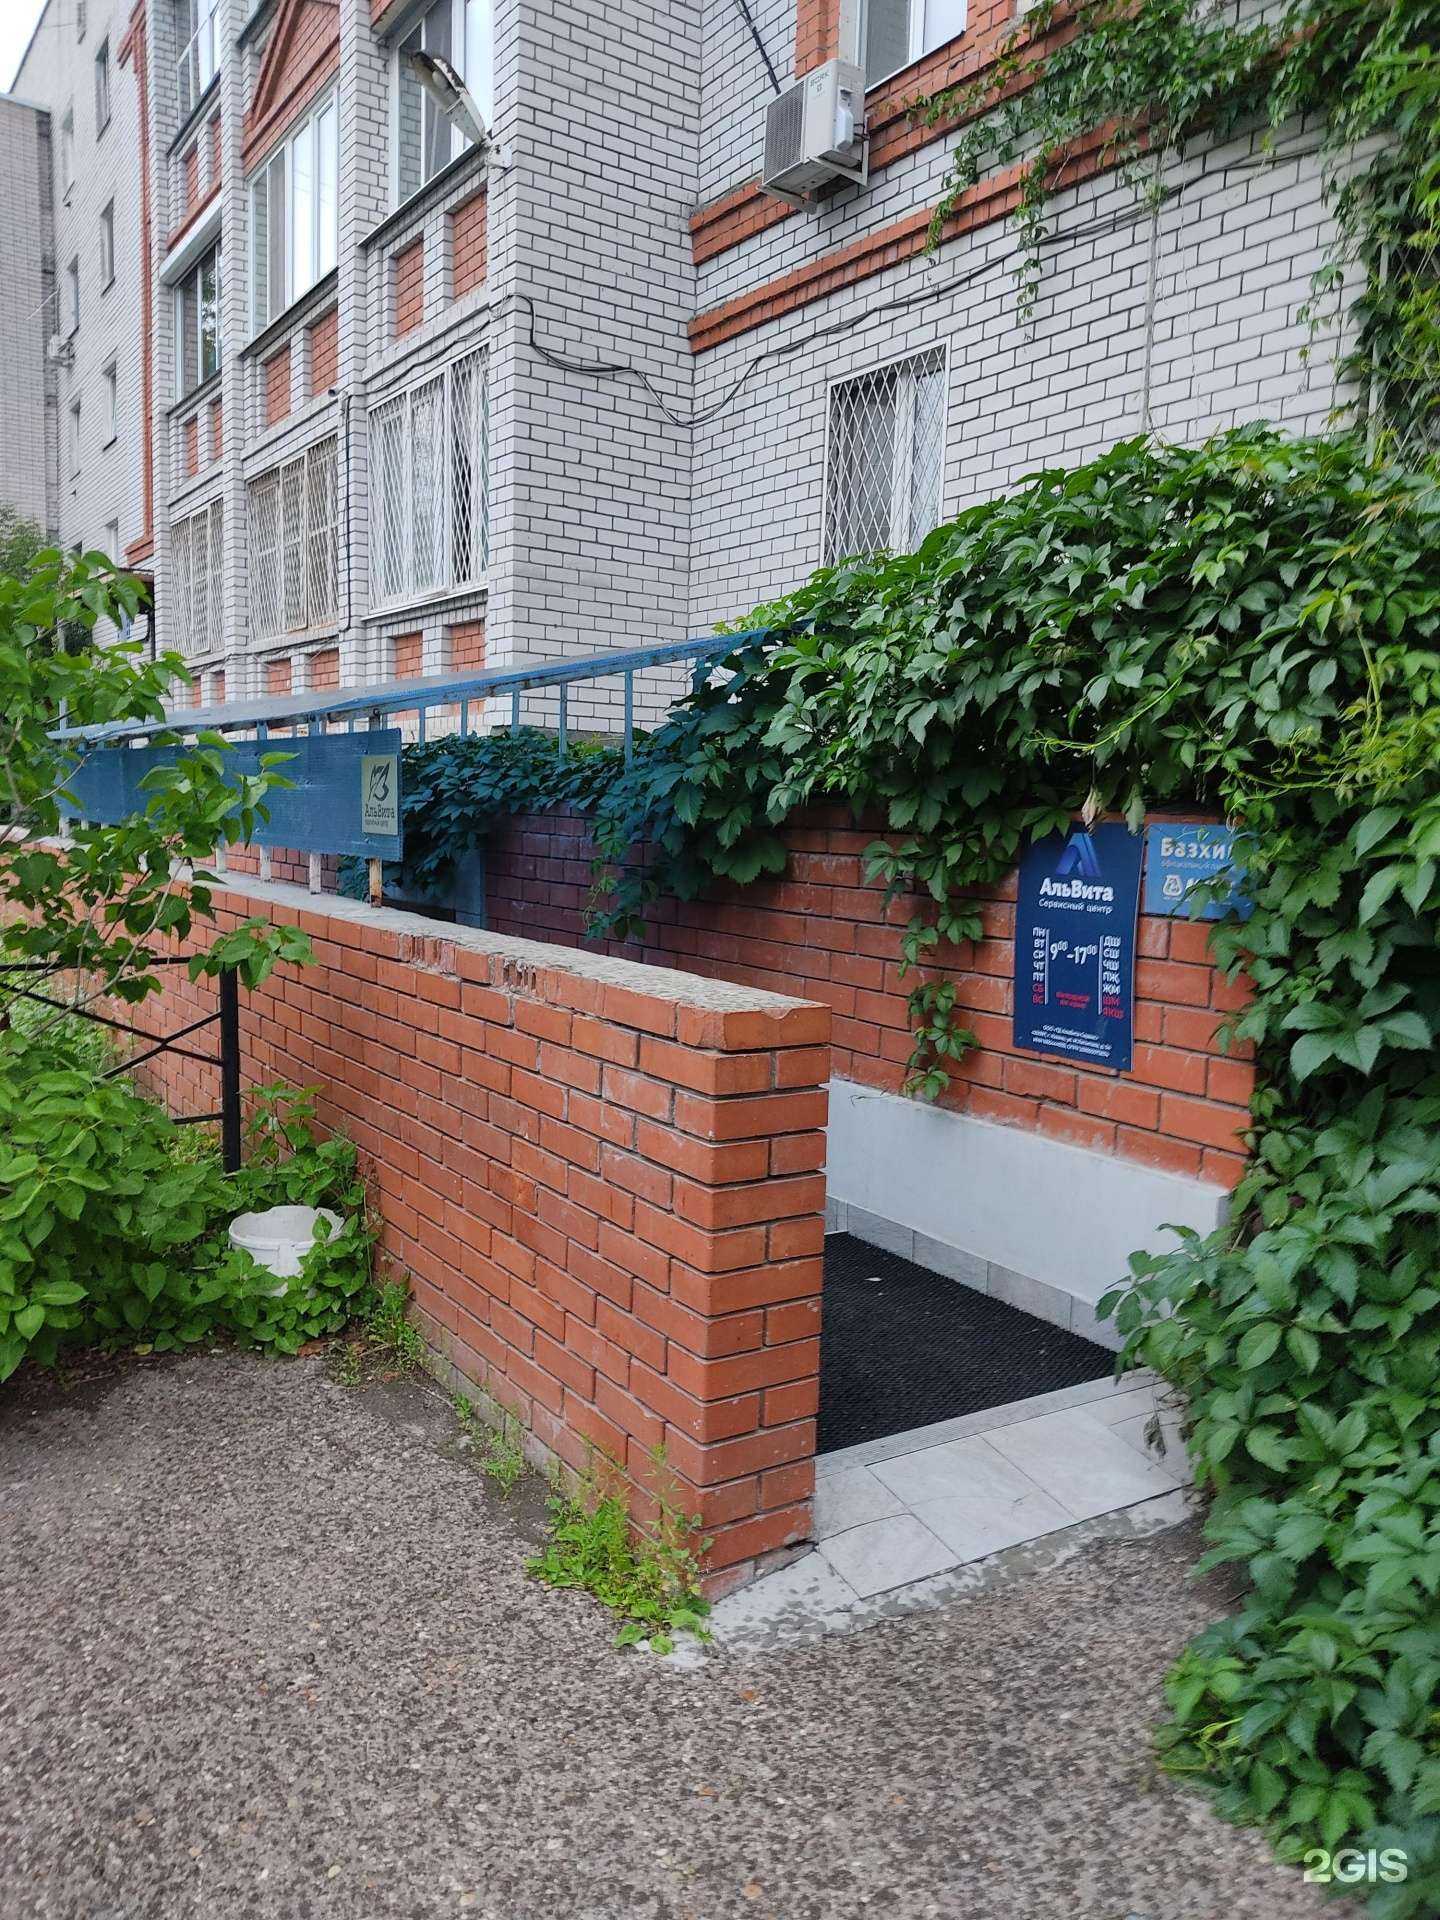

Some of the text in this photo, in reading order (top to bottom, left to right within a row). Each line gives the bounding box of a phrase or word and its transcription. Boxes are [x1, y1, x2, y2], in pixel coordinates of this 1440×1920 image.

[1039, 877, 1114, 902] АльВита
[1038, 897, 1113, 916] Сервисный центр
[1032, 927, 1046, 937] ПН
[1033, 938, 1045, 948] ВТ
[1103, 935, 1121, 947] ДШ
[1032, 949, 1045, 959] СР
[1103, 947, 1120, 959] СШ
[1033, 961, 1045, 971] ЧТ
[1102, 960, 1119, 971] ЧШ
[1032, 972, 1045, 982] ПТ
[1032, 983, 1044, 993] СБ
[1032, 994, 1044, 1004] ВС
